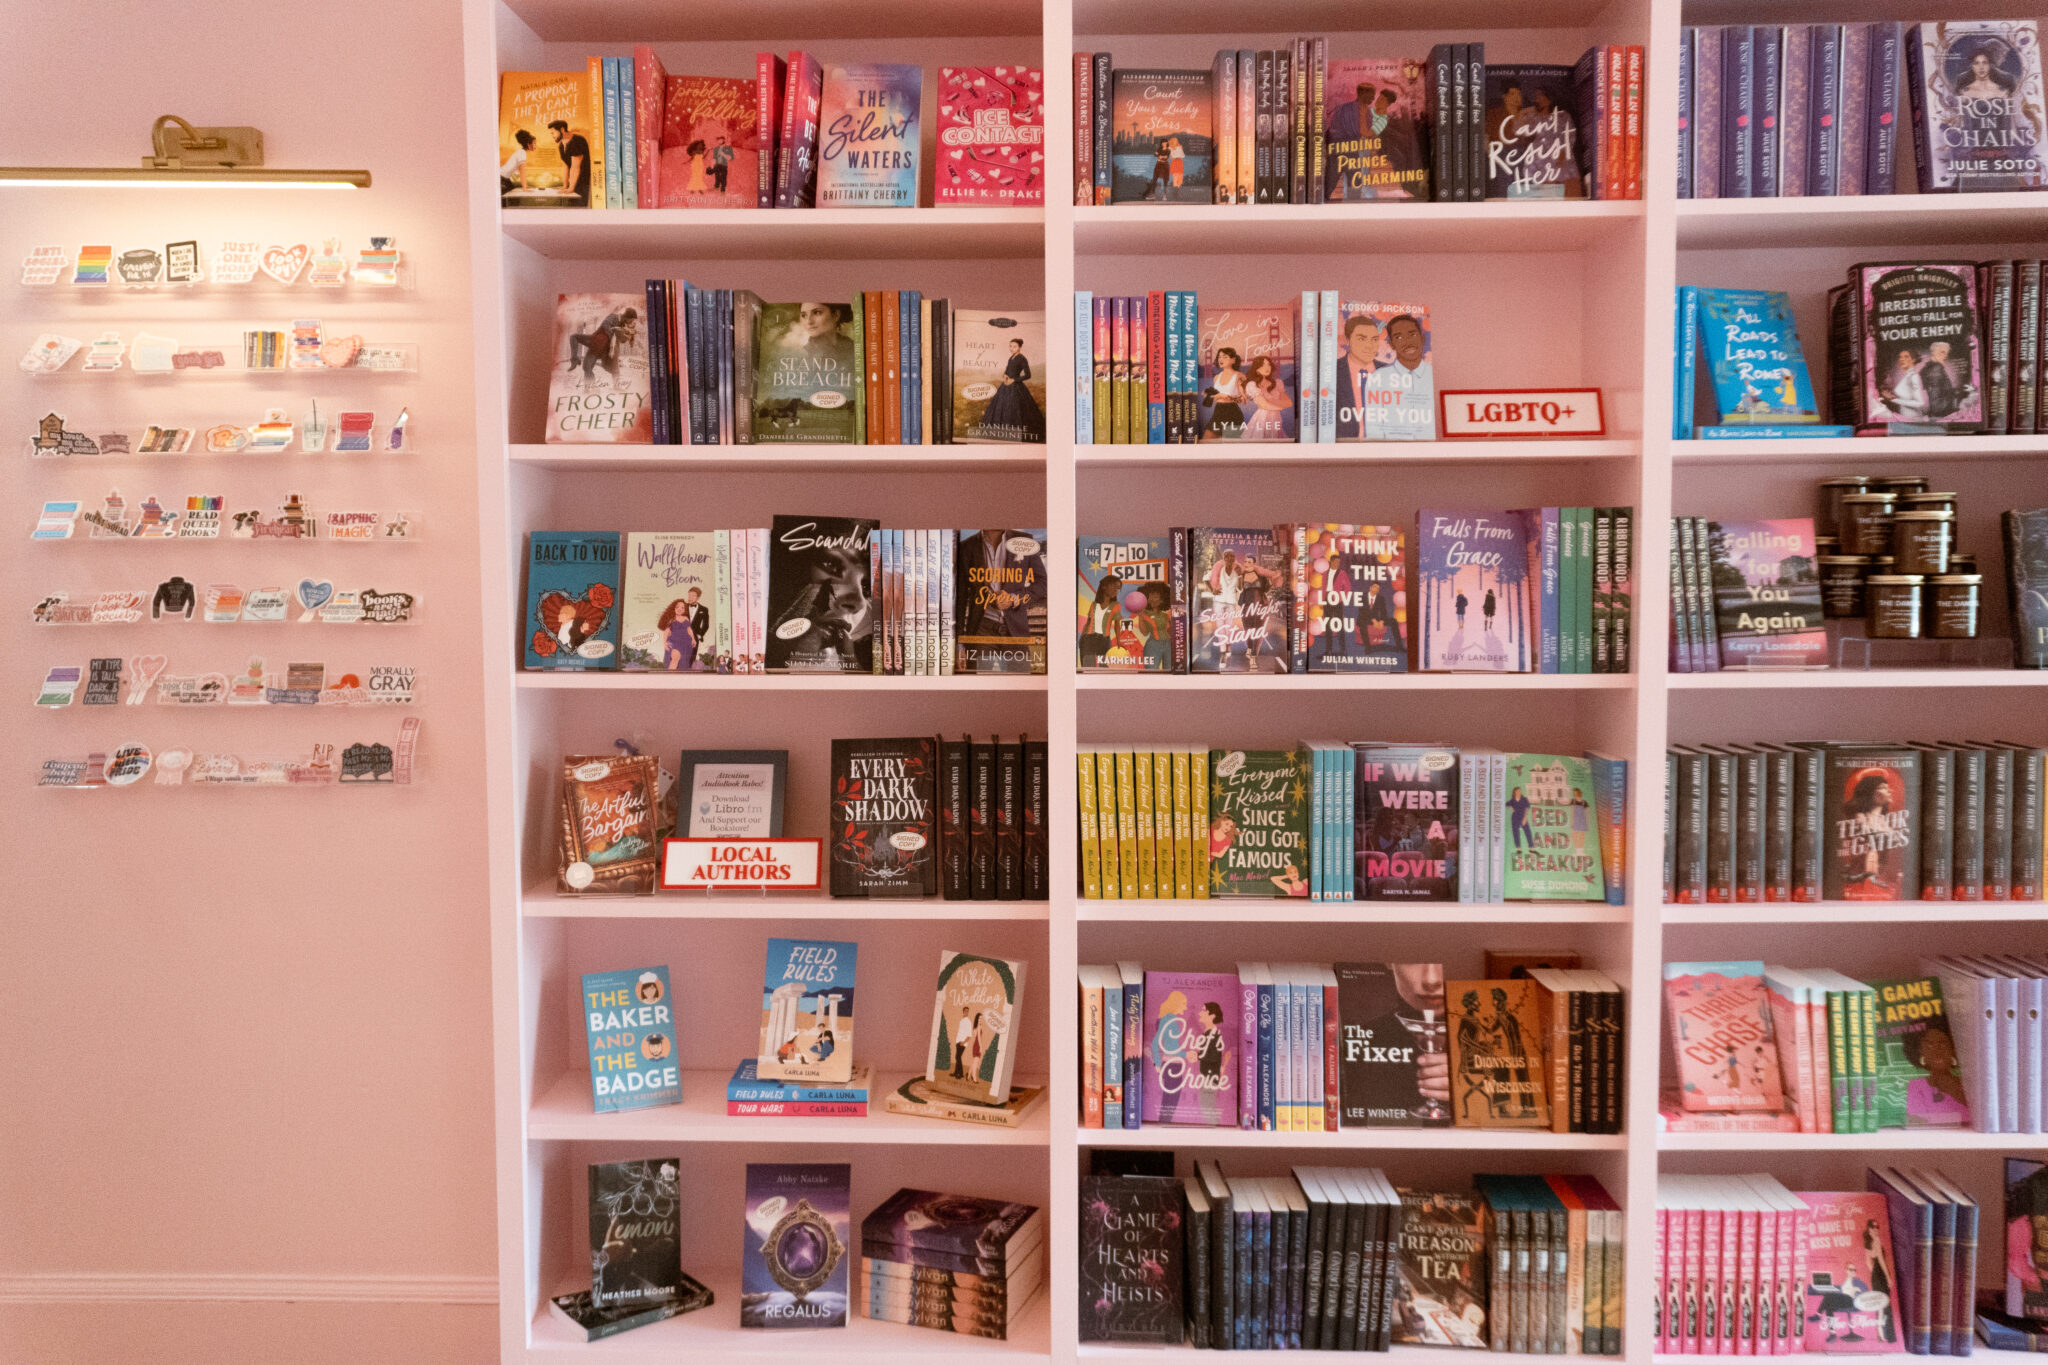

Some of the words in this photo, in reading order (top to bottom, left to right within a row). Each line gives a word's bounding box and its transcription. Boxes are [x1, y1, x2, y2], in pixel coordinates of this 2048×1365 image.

[857, 89, 887, 108] THE
[1143, 85, 1184, 102] Count
[1126, 99, 1158, 120] Your
[1162, 100, 1200, 121] Lucky
[1954, 95, 2018, 119] ROSE
[973, 107, 1010, 128] ICE
[1144, 115, 1181, 132] Stars
[1980, 116, 1998, 129] IN
[821, 110, 915, 161] Silent
[940, 125, 1044, 145] CONTACT
[1943, 126, 2037, 148] CHAINS
[1327, 137, 1382, 155] FINDING
[1487, 121, 1578, 180] Resist
[847, 150, 913, 170] WATERS
[1336, 155, 1388, 173] PRINCE
[1947, 159, 1989, 171] JULIE
[1993, 159, 2037, 171] SOTO
[1351, 169, 1425, 190] CHARMING
[1512, 165, 1562, 194] Her
[941, 187, 976, 199] ELLIE
[979, 188, 994, 200] K.
[998, 188, 1042, 201] DRAKE
[221, 241, 255, 253] JUST
[1879, 294, 1963, 313] IRRESISTIBLE
[1879, 315, 1910, 327] URGE
[1911, 313, 1922, 321] TO
[1923, 311, 1948, 322] FALL
[1200, 311, 1249, 353] Love
[1256, 315, 1280, 329] in
[1880, 326, 1919, 341] YOUR
[1921, 323, 1964, 338] ENEMY
[964, 341, 997, 351] HEART
[1244, 331, 1292, 363] Focus
[1769, 350, 1788, 361] TO
[779, 357, 837, 373] STAND
[772, 371, 853, 388] BREACH
[1357, 371, 1383, 388] I'M
[1388, 372, 1413, 389] SO
[555, 391, 651, 414] FROSTY
[1366, 389, 1405, 405] NOT
[559, 411, 637, 433] CHEER
[1339, 406, 1388, 423] OVER
[1398, 408, 1433, 425] YOU
[1466, 400, 1578, 426] LGBTQ+
[977, 422, 1029, 433] DANIELLE
[1212, 420, 1250, 432] LYLA
[1255, 420, 1282, 432] LEE
[180, 528, 218, 538] BOOKS
[779, 522, 874, 552] Scandal
[1432, 517, 1470, 540] Falls
[1474, 519, 1516, 541] From
[1597, 518, 1608, 582] RIBBONWOOD
[1616, 518, 1628, 582] RIBBONWOOD
[1723, 531, 1802, 552] Falling
[535, 543, 567, 561] BACK
[572, 544, 588, 561] TO
[592, 544, 617, 561] YOU
[637, 542, 712, 570] Wallflower
[1445, 541, 1503, 568] Grace
[968, 567, 1023, 583] SCORING
[1024, 567, 1035, 583] A
[1114, 563, 1162, 580] SPLIT
[1351, 565, 1400, 582] THEY
[974, 585, 1031, 610] Spouse
[1317, 589, 1365, 607] LOVE
[1746, 585, 1790, 602] You
[1318, 615, 1355, 633] YOU
[1737, 612, 1807, 634] Again
[1212, 619, 1269, 648] Stand
[958, 649, 977, 661] LIZ
[981, 649, 1043, 662] LINCOLN
[1728, 640, 1762, 653] Kerry
[1764, 641, 1821, 651] Lonsdale
[1096, 655, 1136, 665] KARMEN
[1138, 656, 1155, 666] LEE
[1321, 654, 1354, 664] JULIAN
[1356, 656, 1398, 665] WINTERS
[1440, 653, 1465, 662] RUBY
[1467, 654, 1509, 663] LANDERS
[370, 666, 416, 676] MORALLY
[369, 675, 416, 691] GRAY
[313, 743, 335, 761] RIP
[849, 757, 908, 780] EVERY
[1229, 766, 1299, 787] Everyone
[1364, 762, 1385, 783] IF
[1393, 763, 1432, 783] WE
[711, 795, 750, 803] Download
[863, 777, 921, 802] DARK
[1222, 792, 1235, 813] I
[1237, 781, 1289, 811] Kissed
[715, 804, 744, 814] Libro
[845, 799, 928, 822] SHADOW
[1379, 790, 1449, 811] WERE
[1241, 807, 1286, 827] SINCE
[1531, 806, 1569, 828] BED
[1236, 828, 1268, 849] YOU
[1270, 831, 1301, 849] GOT
[1426, 820, 1446, 841] A
[1533, 831, 1570, 851] AND
[711, 846, 777, 863] LOCAL
[1229, 849, 1292, 869] FAMOUS
[1510, 854, 1595, 874] BREAKUP
[691, 863, 791, 881] AUTHORS
[1366, 858, 1447, 879] MOVIE
[859, 880, 884, 888] SARAH
[887, 880, 909, 888] ZIMM
[789, 946, 837, 965] FIELD
[782, 964, 838, 984] RULES
[957, 968, 994, 987] White
[587, 989, 630, 1009] THE
[1882, 980, 1934, 1003] GAME
[1682, 989, 1758, 1021] THRILL
[1885, 999, 1942, 1023] AFOOT
[589, 1005, 670, 1032] BAKER
[593, 1033, 636, 1051] AND
[1158, 1016, 1226, 1060] Chef's
[1345, 1025, 1374, 1040] The
[1684, 1015, 1766, 1065] CHASE
[593, 1051, 637, 1073] THE
[1346, 1040, 1414, 1064] Fixer
[595, 1067, 679, 1097] BADGE
[783, 1068, 803, 1077] CARLA
[804, 1069, 820, 1077] LUNA
[1158, 1058, 1232, 1094] Choice
[1555, 1056, 1569, 1101] TROTH
[735, 1089, 758, 1099] FIELD
[760, 1090, 784, 1100] RULES
[807, 1091, 834, 1100] CARLA
[835, 1091, 856, 1100] LUNA
[1484, 1079, 1543, 1094] WISCONSIN
[736, 1103, 757, 1114] TOUR
[759, 1103, 784, 1114] WARS
[809, 1105, 835, 1114] CARLA
[836, 1105, 858, 1114] LUNA
[961, 1110, 988, 1122] CARLA
[988, 1114, 1008, 1125] LUNA
[1347, 1107, 1365, 1118] LEE
[1367, 1107, 1407, 1119] WINTER
[1130, 1194, 1140, 1206] A
[1103, 1208, 1166, 1232] GAME
[603, 1218, 676, 1248] Lemon
[1124, 1230, 1143, 1243] OF
[1398, 1232, 1475, 1253] TREASON
[1097, 1244, 1169, 1265] HEARTS
[1416, 1255, 1461, 1281] TEA
[602, 1289, 642, 1301] HEATHER
[643, 1286, 676, 1298] MOORE
[1102, 1281, 1164, 1304] HEISTS
[765, 1304, 832, 1318] REGALUS
